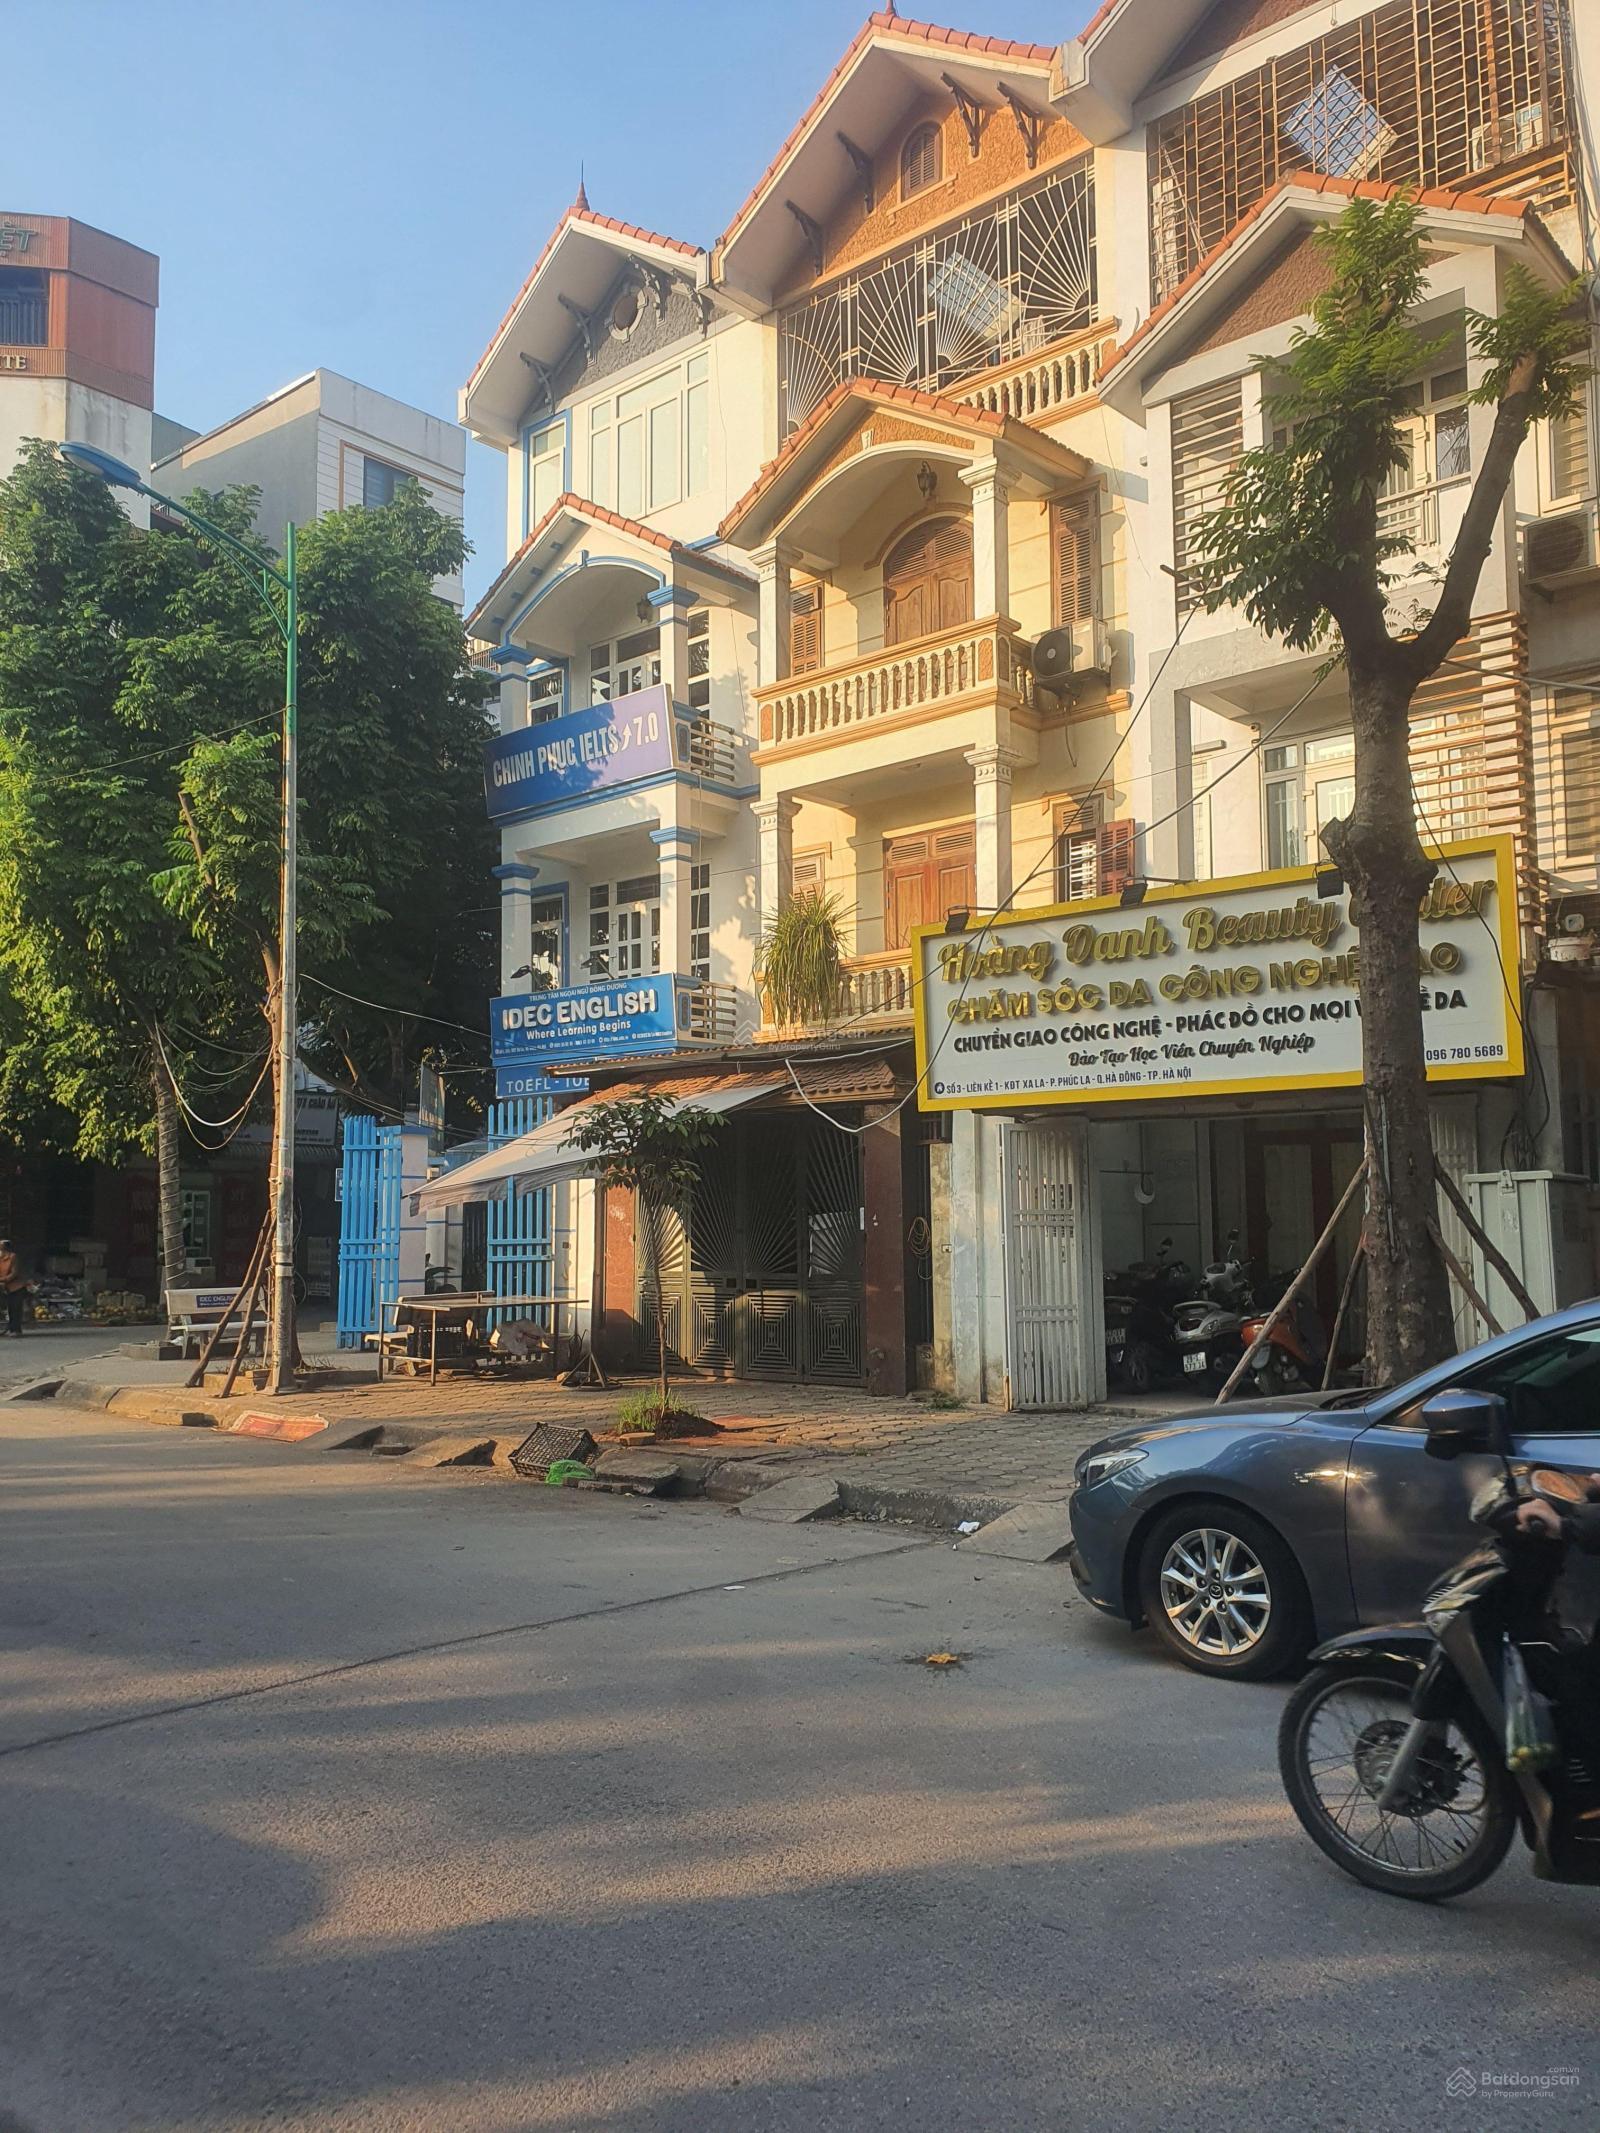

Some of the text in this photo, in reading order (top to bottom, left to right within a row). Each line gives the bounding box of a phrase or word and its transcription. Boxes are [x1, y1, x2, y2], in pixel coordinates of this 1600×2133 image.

[0, 355, 27, 369] TE
[493, 751, 535, 787] CHINH
[579, 725, 619, 762] IELTS
[633, 712, 659, 746] 7.0
[937, 935, 1056, 982] Hoàng
[1062, 915, 1175, 965] Oanh
[1182, 896, 1342, 949] Beauty
[502, 988, 656, 1030] IDEC ENGLISH
[947, 988, 1030, 1023] CHĂM
[1037, 977, 1103, 1014] SỐC
[1109, 978, 1153, 1007] DA
[1159, 964, 1260, 1001] CÔNG
[526, 1019, 631, 1040] Where Learning Begins
[1013, 1027, 1058, 1048] GIAO
[1061, 1022, 1109, 1043] CÔNG
[1113, 1015, 1162, 1039] NGHỆ
[1176, 1009, 1226, 1033] PHÁC
[1228, 1001, 1259, 1028] ĐỒ
[1262, 1004, 1306, 1026] CHO
[1309, 1000, 1351, 1023] MỌI
[1434, 990, 1467, 1010] DA
[1068, 1049, 1099, 1067] Đào
[1100, 1048, 1129, 1067] Tạo
[1129, 1046, 1158, 1065] Học
[1199, 1038, 1256, 1059] Chuyên
[1258, 1032, 1315, 1055] Nghiệp
[1426, 1044, 1504, 1061] 096 780 5689
[506, 1078, 551, 1093] TOEFL
[1023, 1079, 1033, 1089] XA
[1035, 1078, 1045, 1088] LA
[1080, 1075, 1091, 1085] LA
[1119, 1070, 1141, 1083] ĐÔNG
[1162, 1066, 1174, 1079] HÀ
[1177, 1065, 1191, 1080] NỘI
